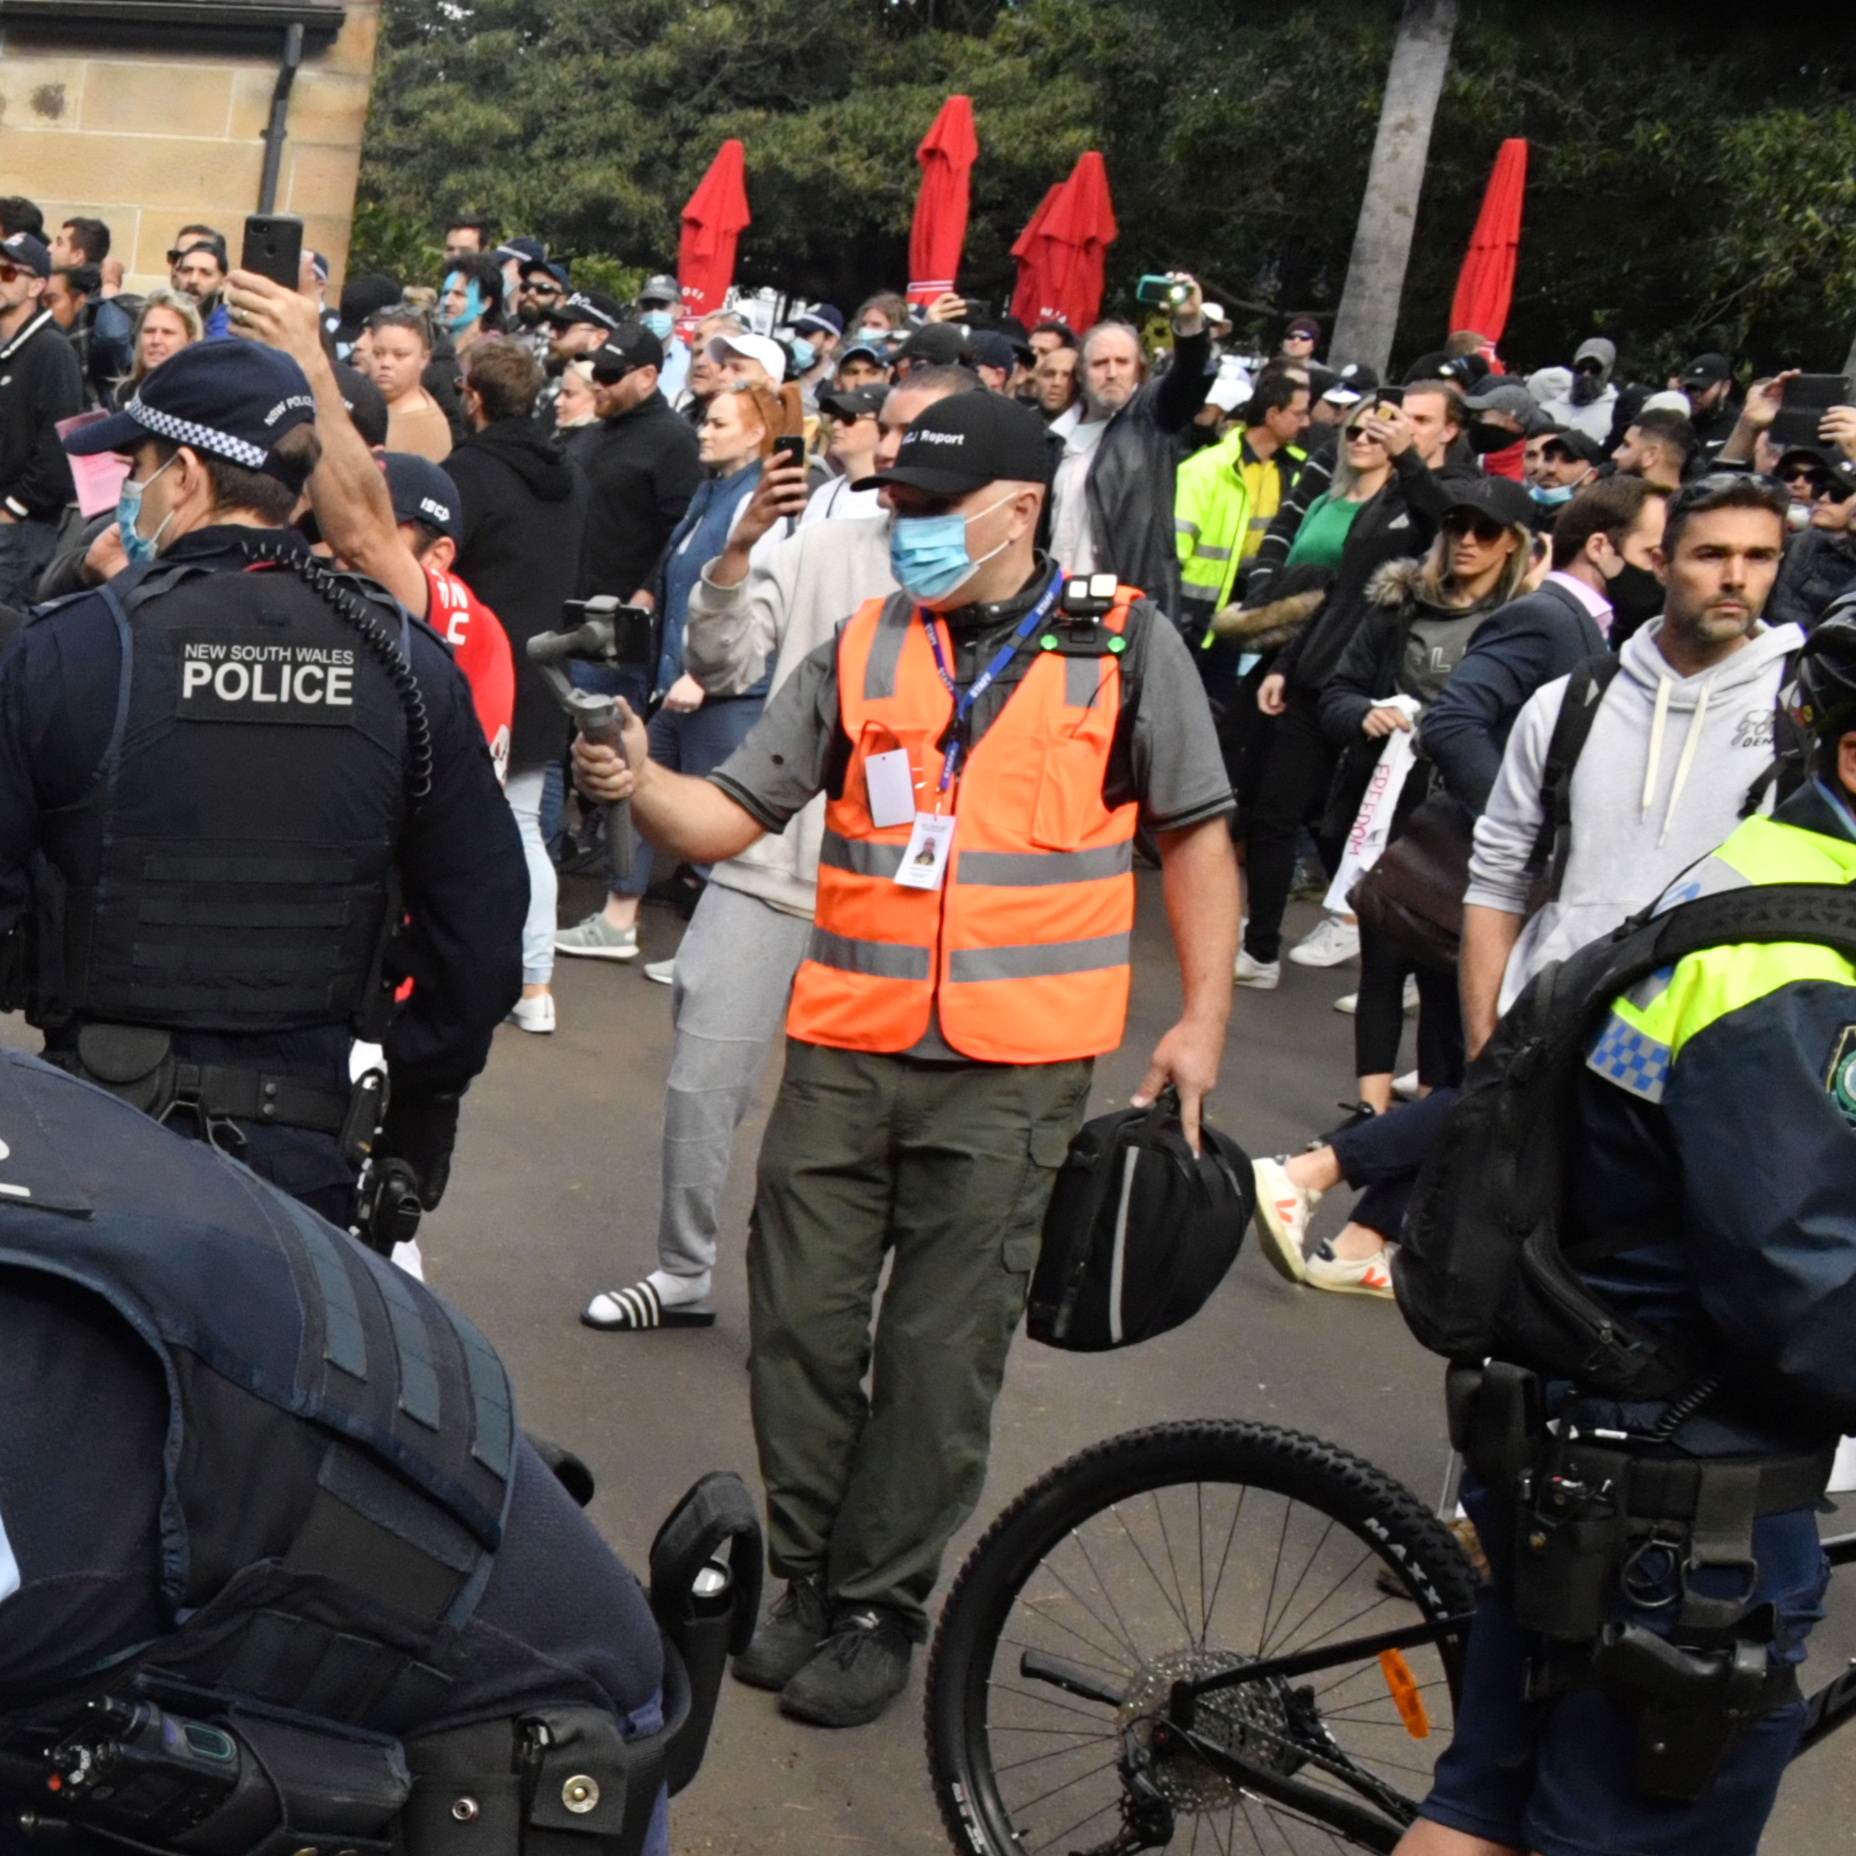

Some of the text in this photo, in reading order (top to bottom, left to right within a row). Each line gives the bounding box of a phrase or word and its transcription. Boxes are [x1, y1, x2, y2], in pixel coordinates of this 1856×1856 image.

[264, 400, 287, 427] NSW
[919, 429, 965, 446] Report
[185, 644, 354, 665] NEW SOUTH WALES
[183, 661, 354, 705] POLICE
[969, 671, 992, 699] STAFF
